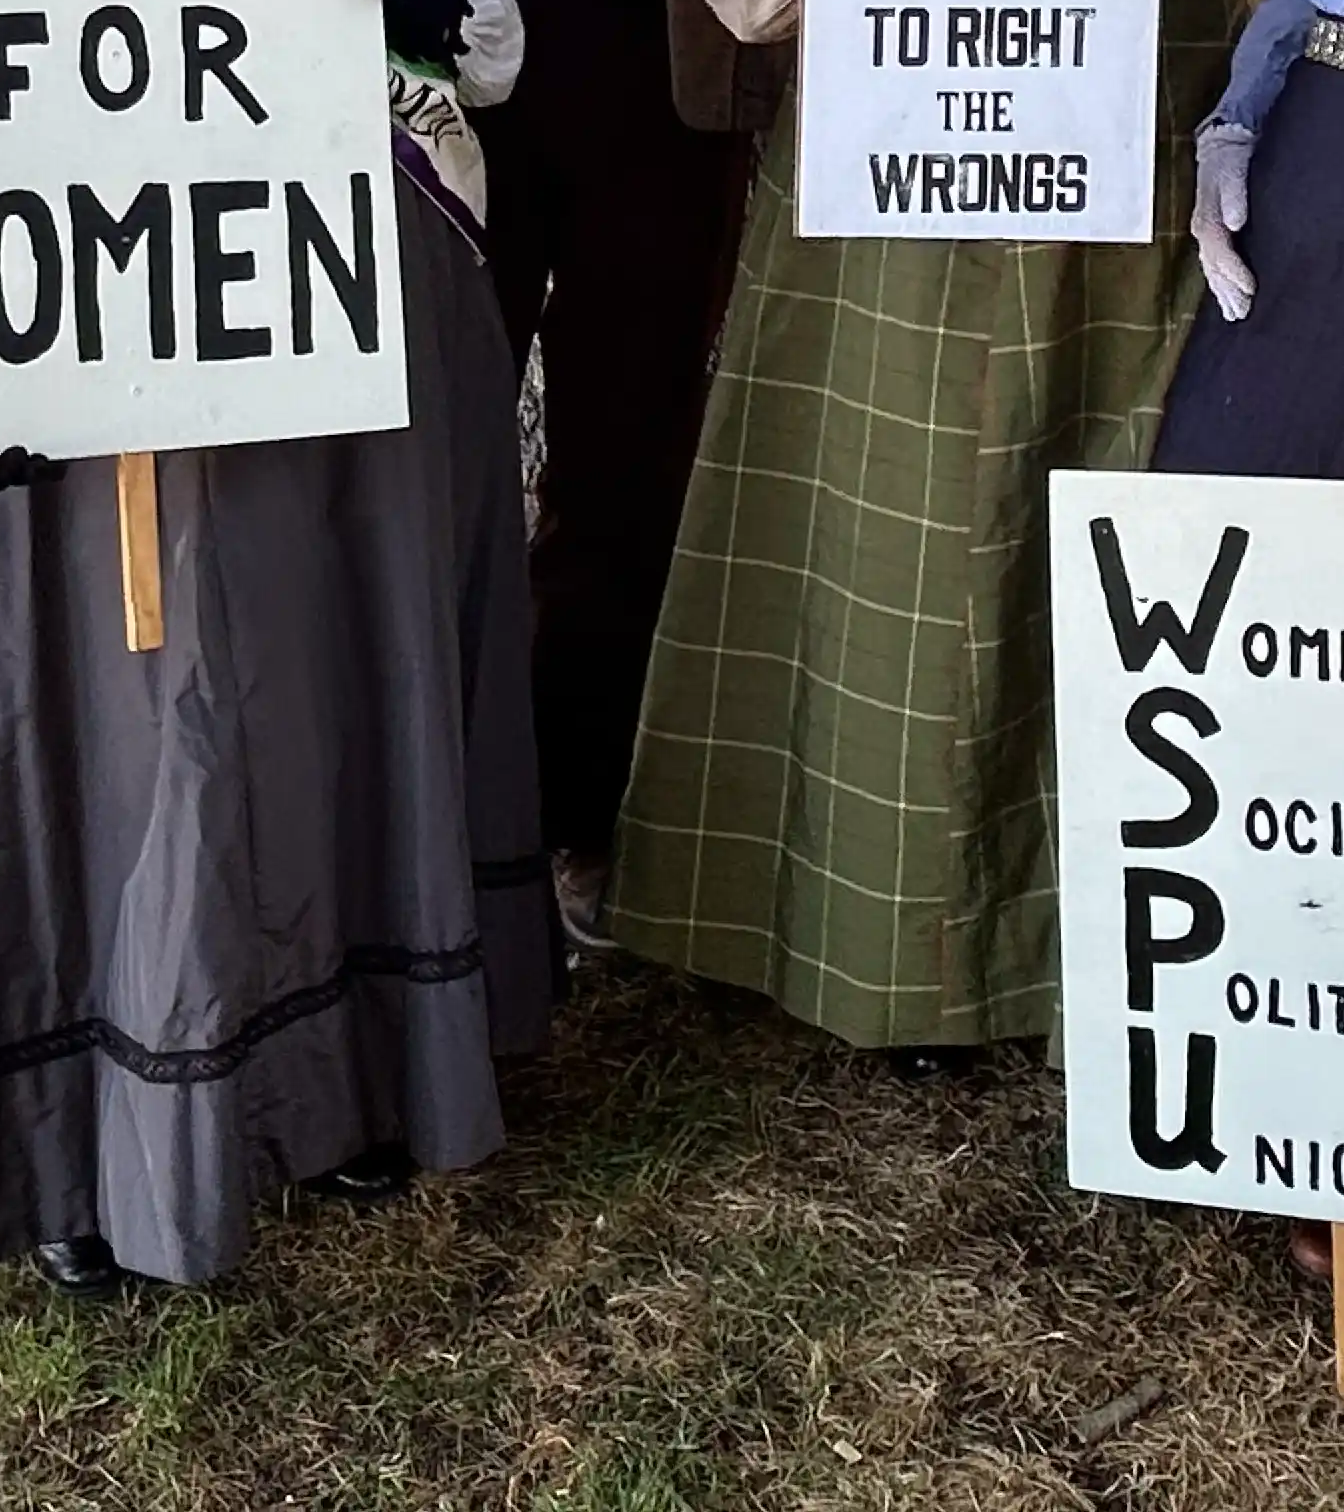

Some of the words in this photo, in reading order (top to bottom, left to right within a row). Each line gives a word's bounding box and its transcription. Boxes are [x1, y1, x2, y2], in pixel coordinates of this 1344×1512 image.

[864, 7, 930, 68] TO
[944, 3, 1098, 70] RIGHT
[936, 91, 1013, 132] THE
[869, 153, 1088, 214] WRONGS
